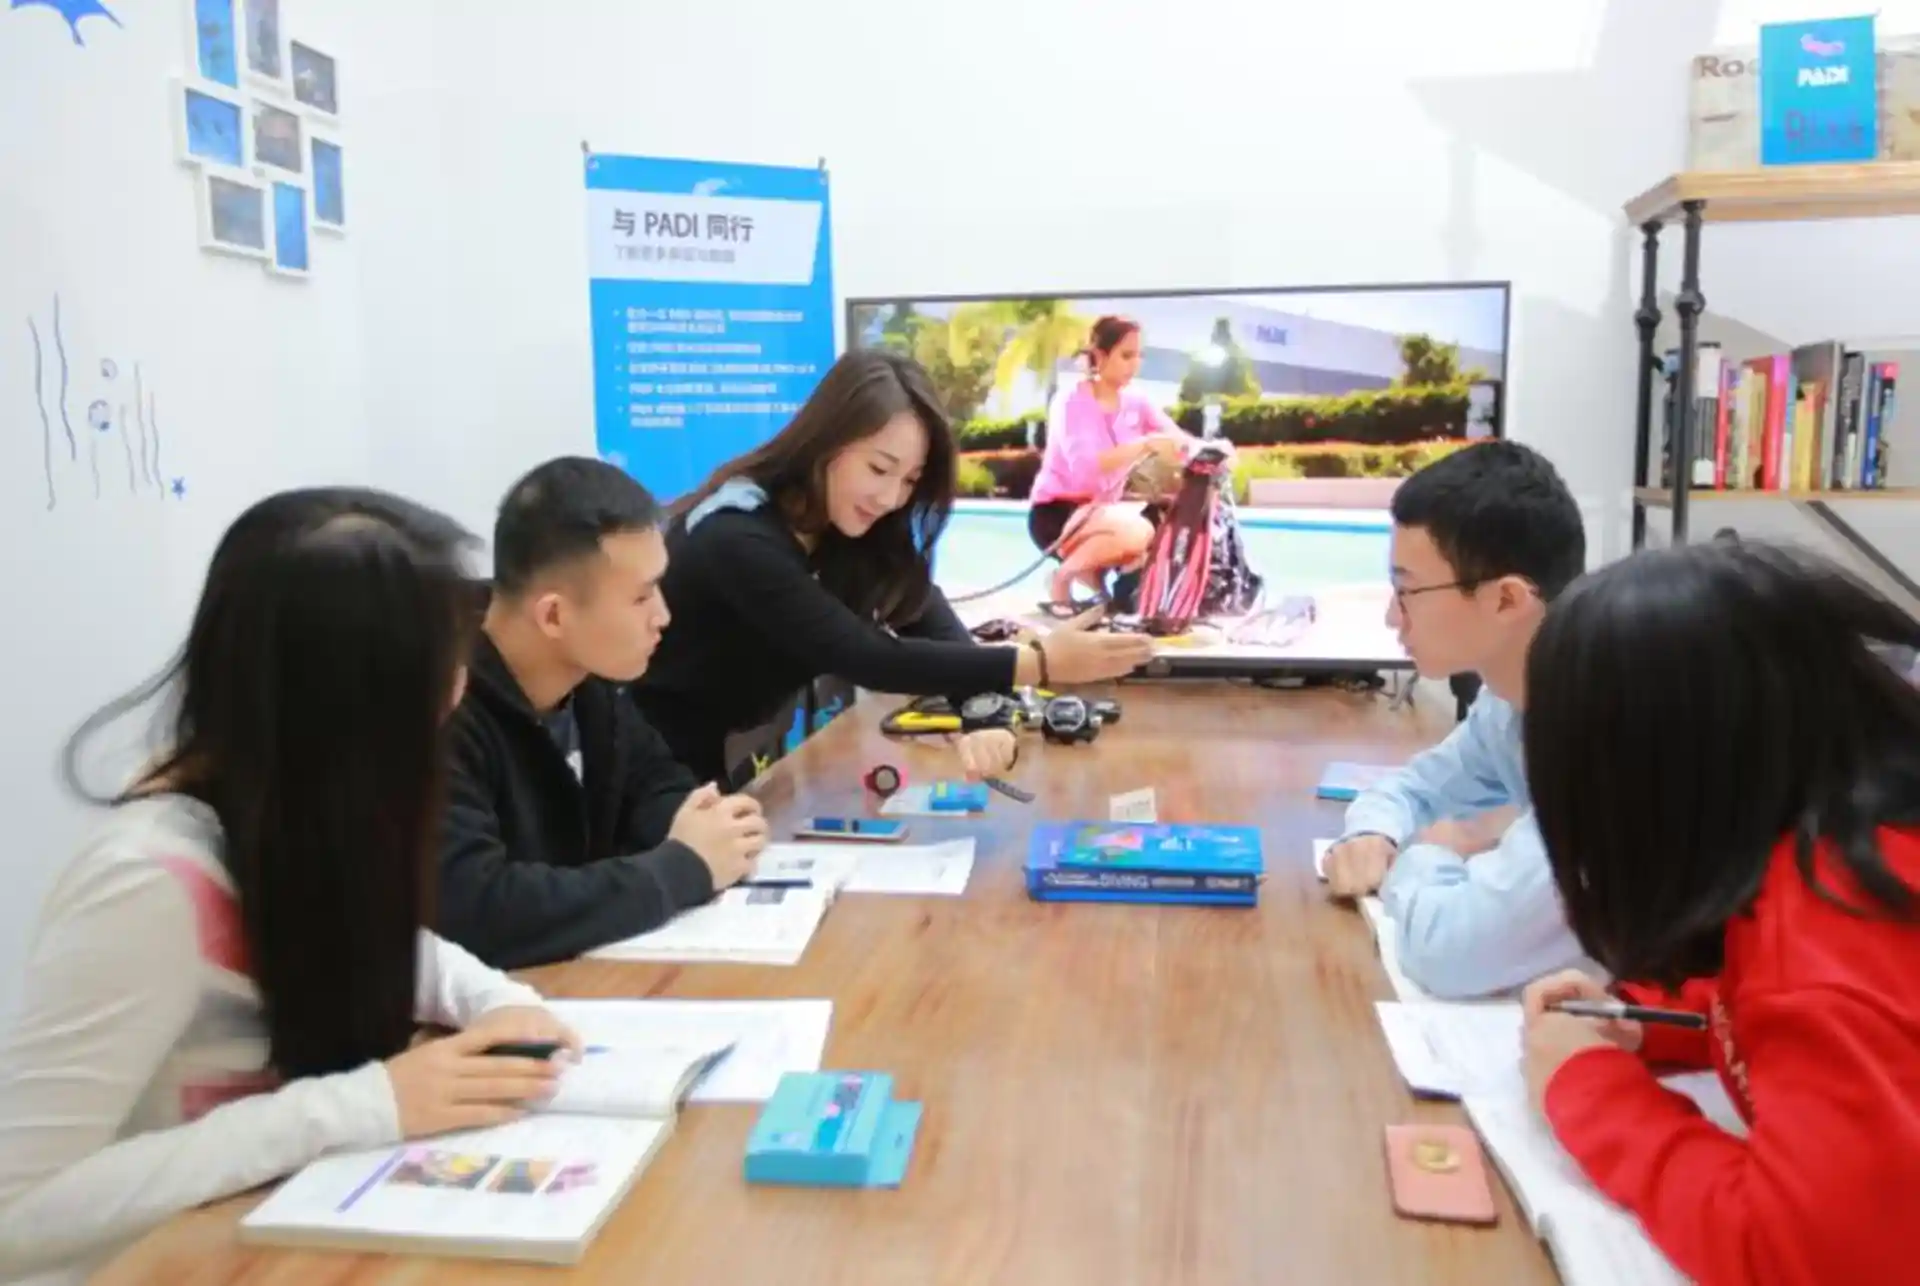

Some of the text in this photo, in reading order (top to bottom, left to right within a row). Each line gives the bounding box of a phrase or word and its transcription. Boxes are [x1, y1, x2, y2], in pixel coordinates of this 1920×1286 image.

[1797, 66, 1850, 87] PADI
[612, 208, 755, 242] 与 PADI 同行
